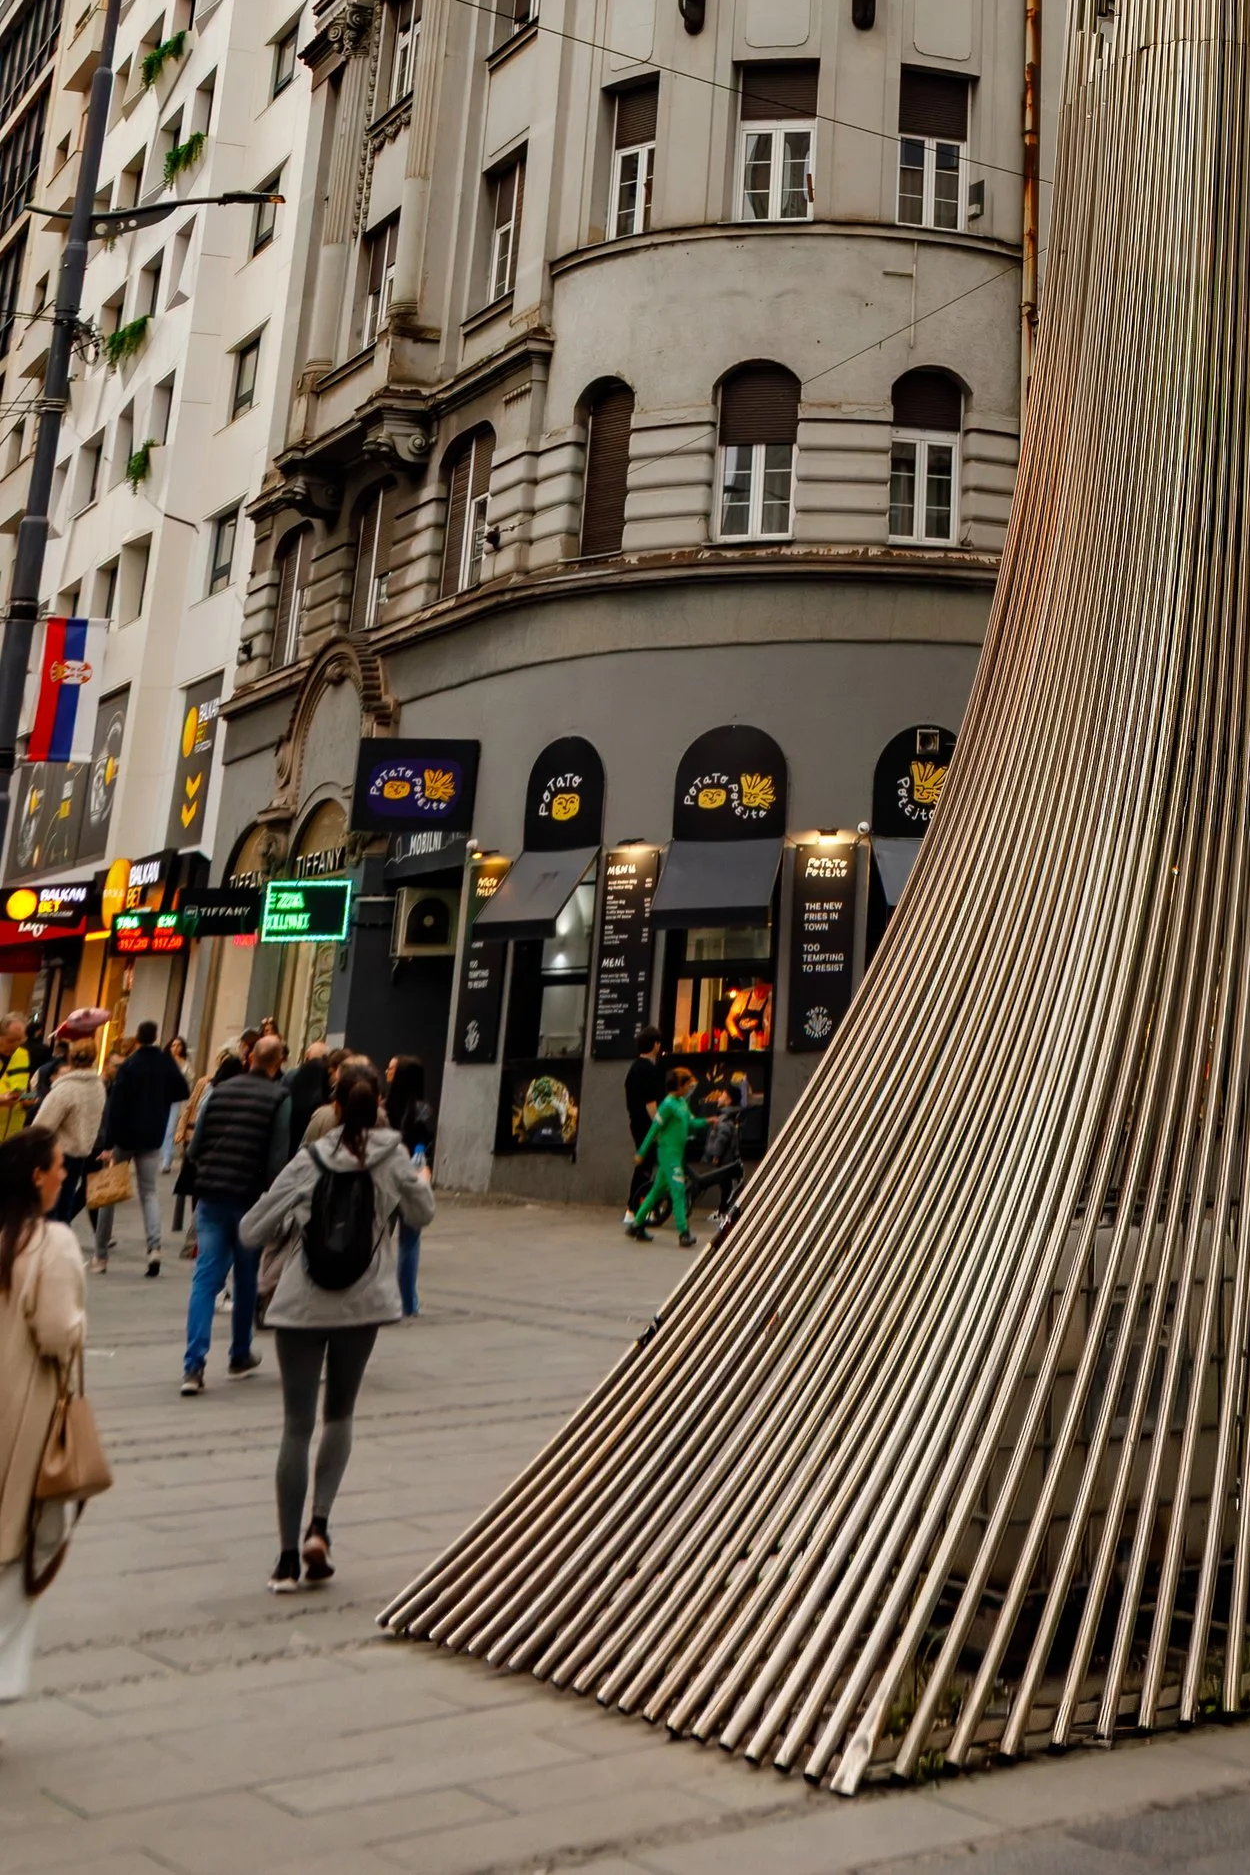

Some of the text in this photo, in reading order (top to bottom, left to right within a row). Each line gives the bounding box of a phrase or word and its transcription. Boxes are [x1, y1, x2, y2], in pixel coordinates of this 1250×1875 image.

[296, 847, 342, 880] TIFFANY
[40, 887, 87, 902] BALKAN
[805, 901, 843, 911] THE NEW
[200, 906, 250, 917] TIFFANY
[804, 911, 839, 921] FRIES IN
[804, 923, 829, 931] TOWN
[803, 943, 821, 952] TOO
[802, 952, 845, 962] TEMPTING
[802, 963, 844, 973] TO RESIST
